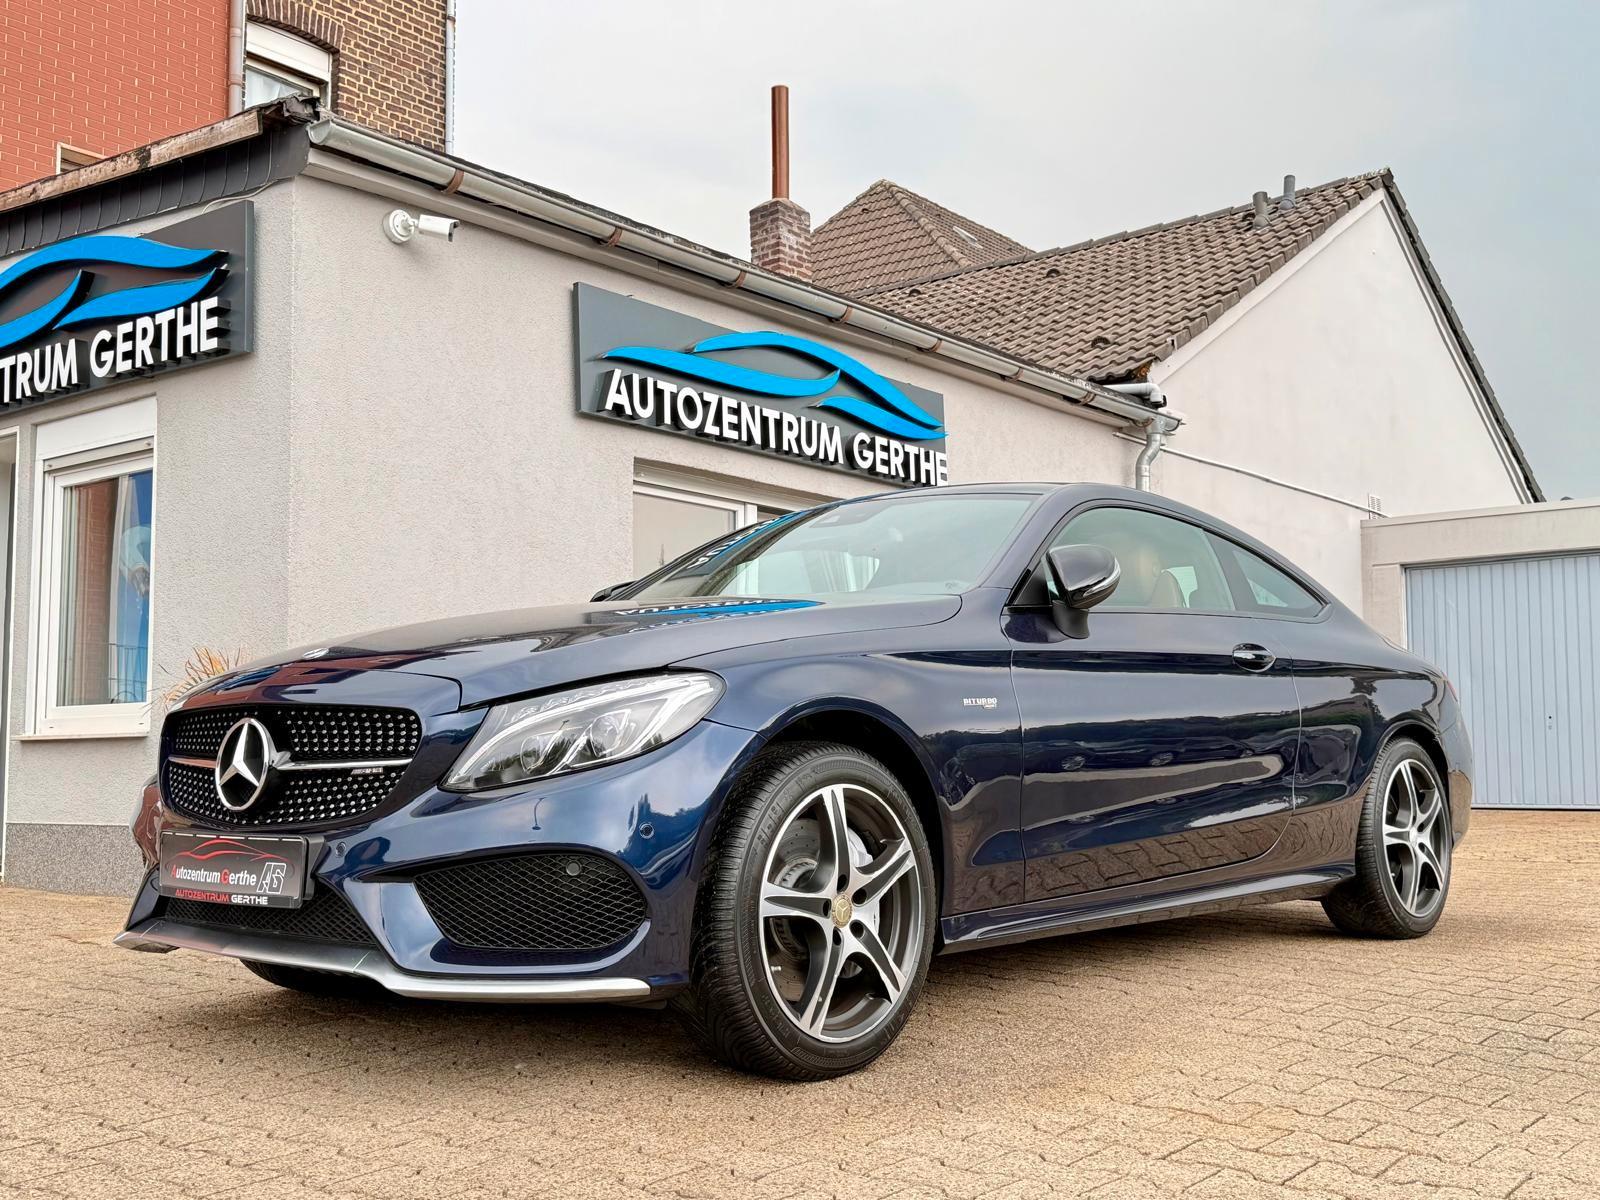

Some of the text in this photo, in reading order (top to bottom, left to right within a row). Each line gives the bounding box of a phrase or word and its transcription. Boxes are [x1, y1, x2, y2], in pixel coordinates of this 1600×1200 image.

[90, 296, 218, 378] GERTHE
[604, 368, 948, 486] AUTOZENTRUM GERTHE
[175, 889, 269, 905] AUTOZENTRUM GERTHE
